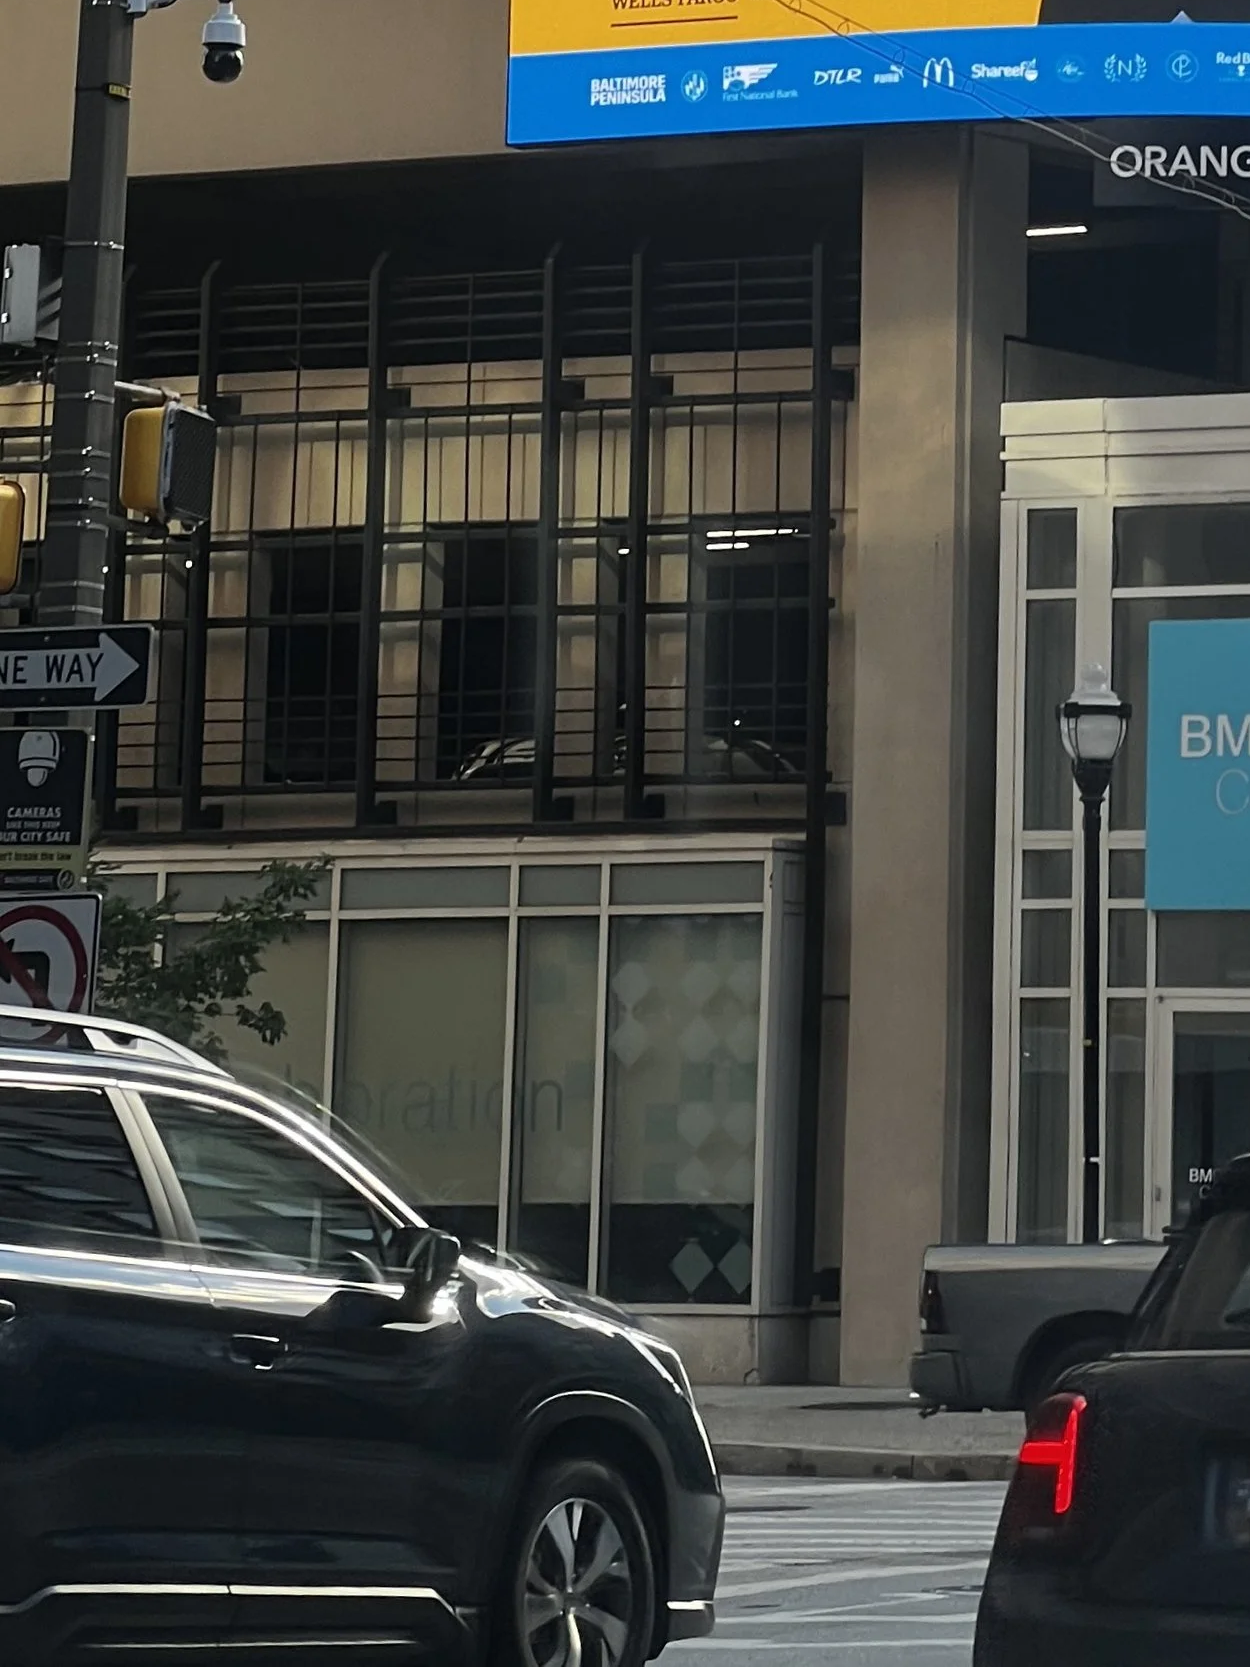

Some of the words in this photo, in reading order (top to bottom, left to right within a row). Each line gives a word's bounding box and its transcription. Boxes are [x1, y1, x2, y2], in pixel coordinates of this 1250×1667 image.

[591, 75, 666, 92] BALTIMORE
[813, 68, 862, 85] DTLR
[590, 89, 666, 106] PENINSULA
[722, 91, 738, 102] First
[740, 89, 776, 101] National
[776, 89, 798, 100] Bank
[46, 652, 104, 684] WAY
[7, 807, 61, 818] CAMERAS
[20, 832, 43, 842] CITY
[46, 831, 71, 843] SAFE
